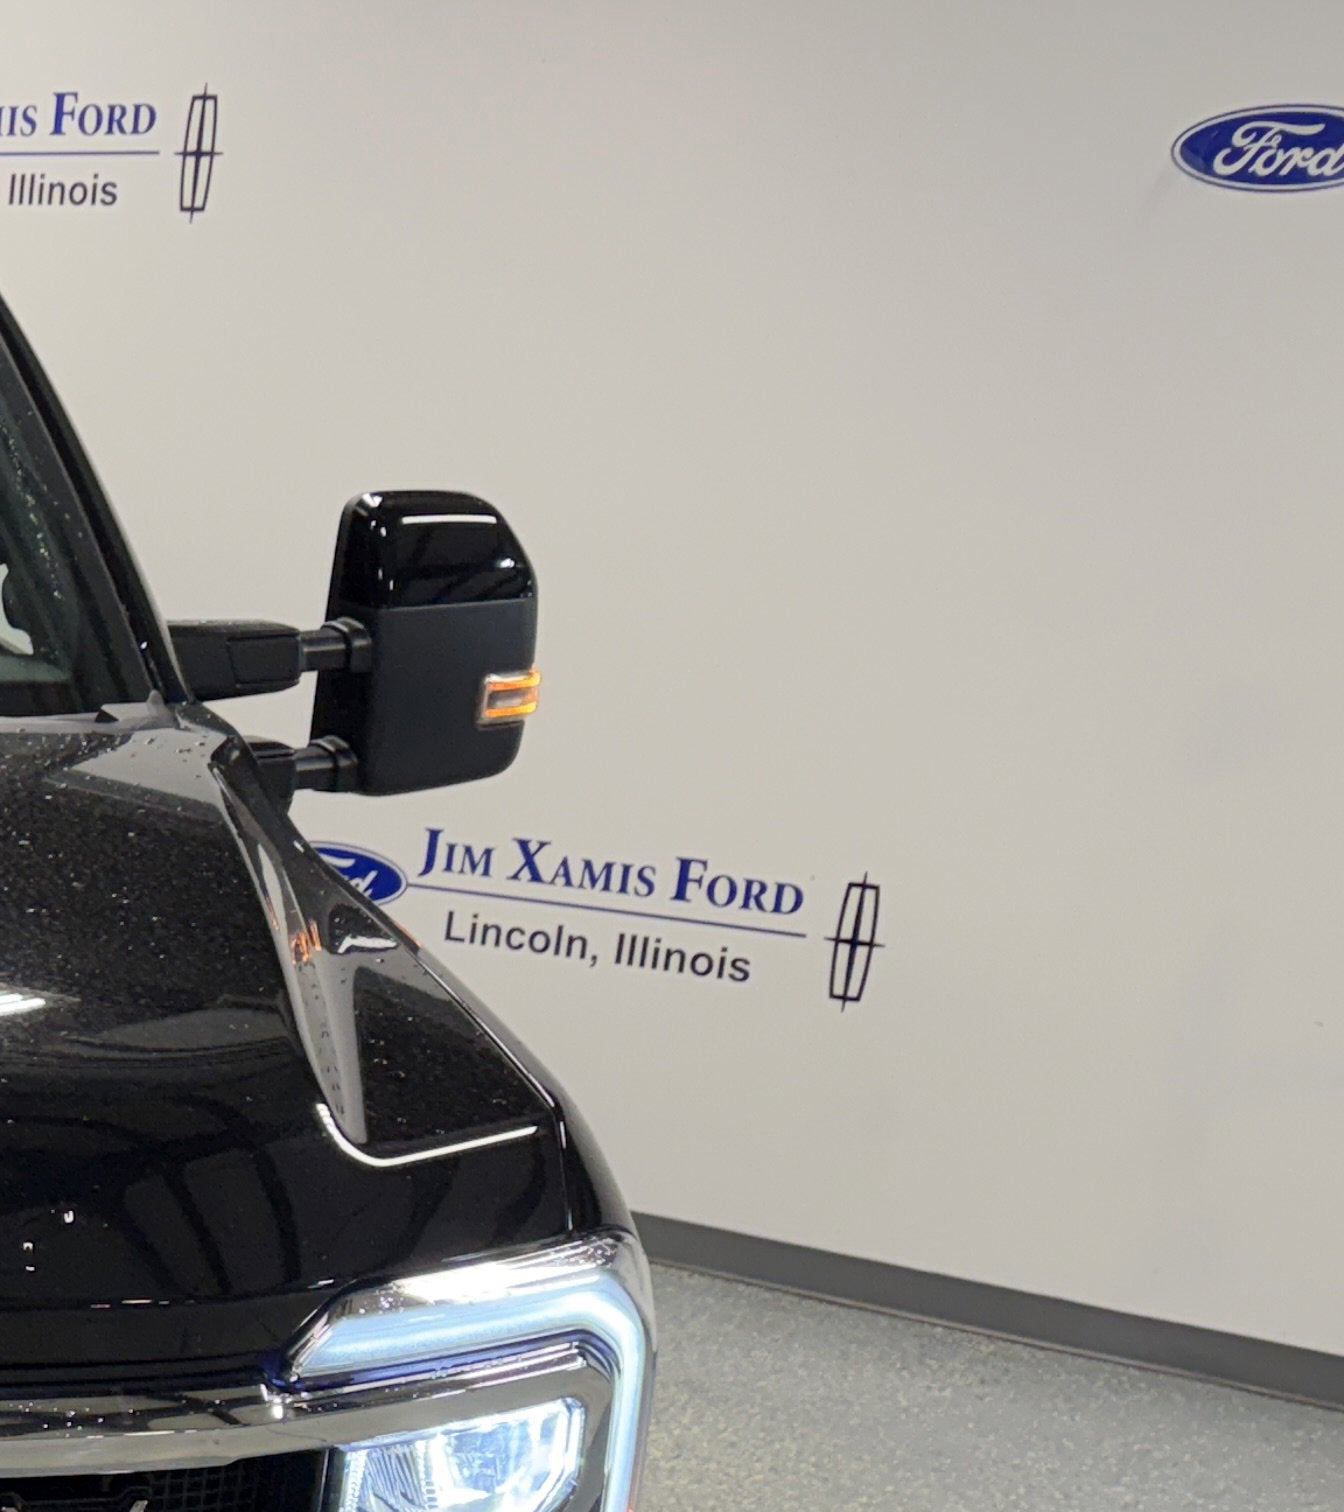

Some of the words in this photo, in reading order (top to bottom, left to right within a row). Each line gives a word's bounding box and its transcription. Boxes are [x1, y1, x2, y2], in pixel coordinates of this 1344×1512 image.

[7, 172, 119, 207] Illinois
[443, 909, 600, 967] Lincoln,
[614, 932, 752, 983] Illinois
